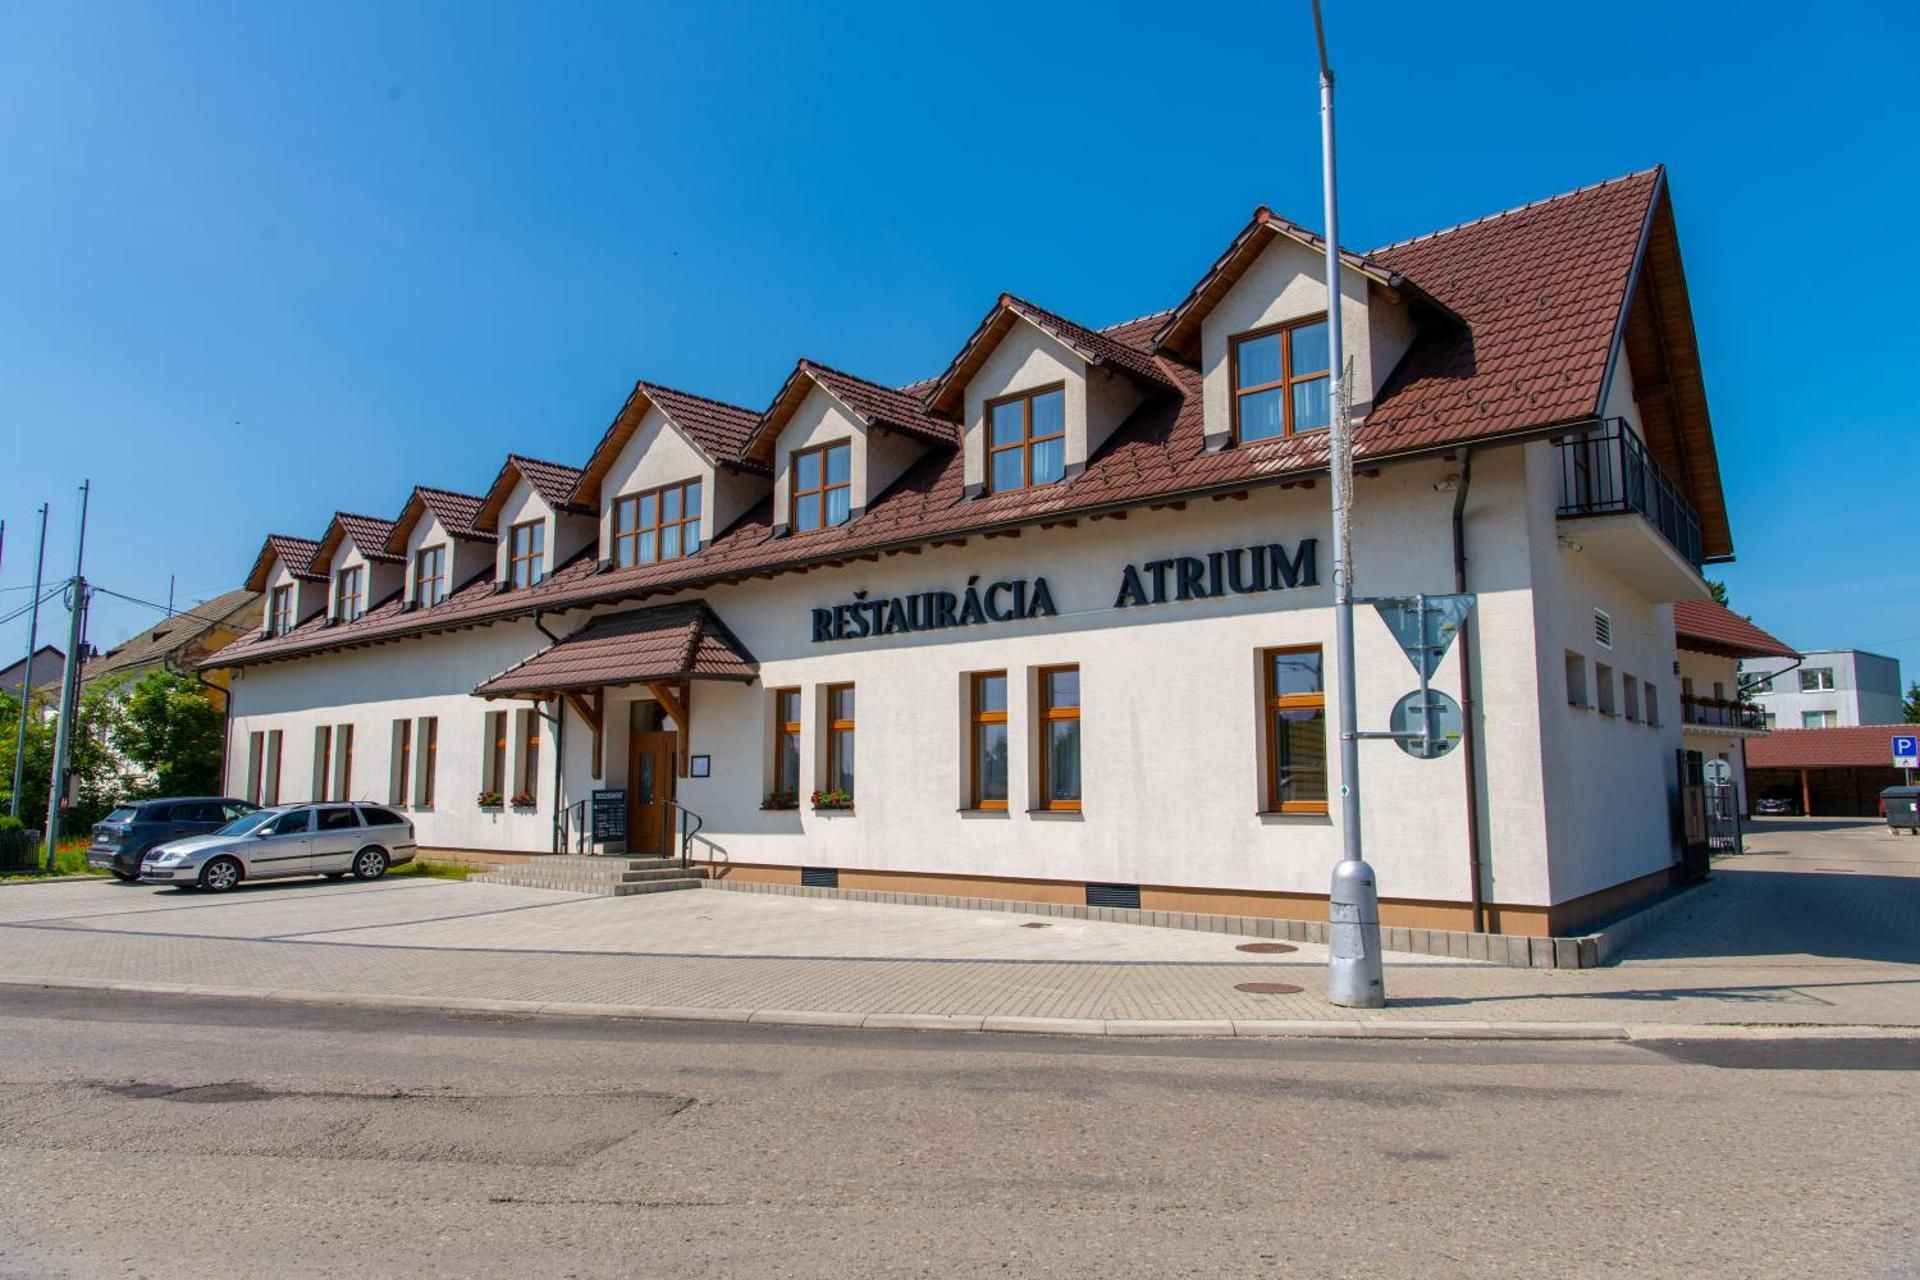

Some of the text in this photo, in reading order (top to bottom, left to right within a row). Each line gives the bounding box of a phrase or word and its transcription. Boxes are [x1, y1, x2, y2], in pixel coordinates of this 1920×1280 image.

[811, 538, 1320, 643] REŠTAURÁCIA ATRIUM
[1898, 739, 1912, 754] P
